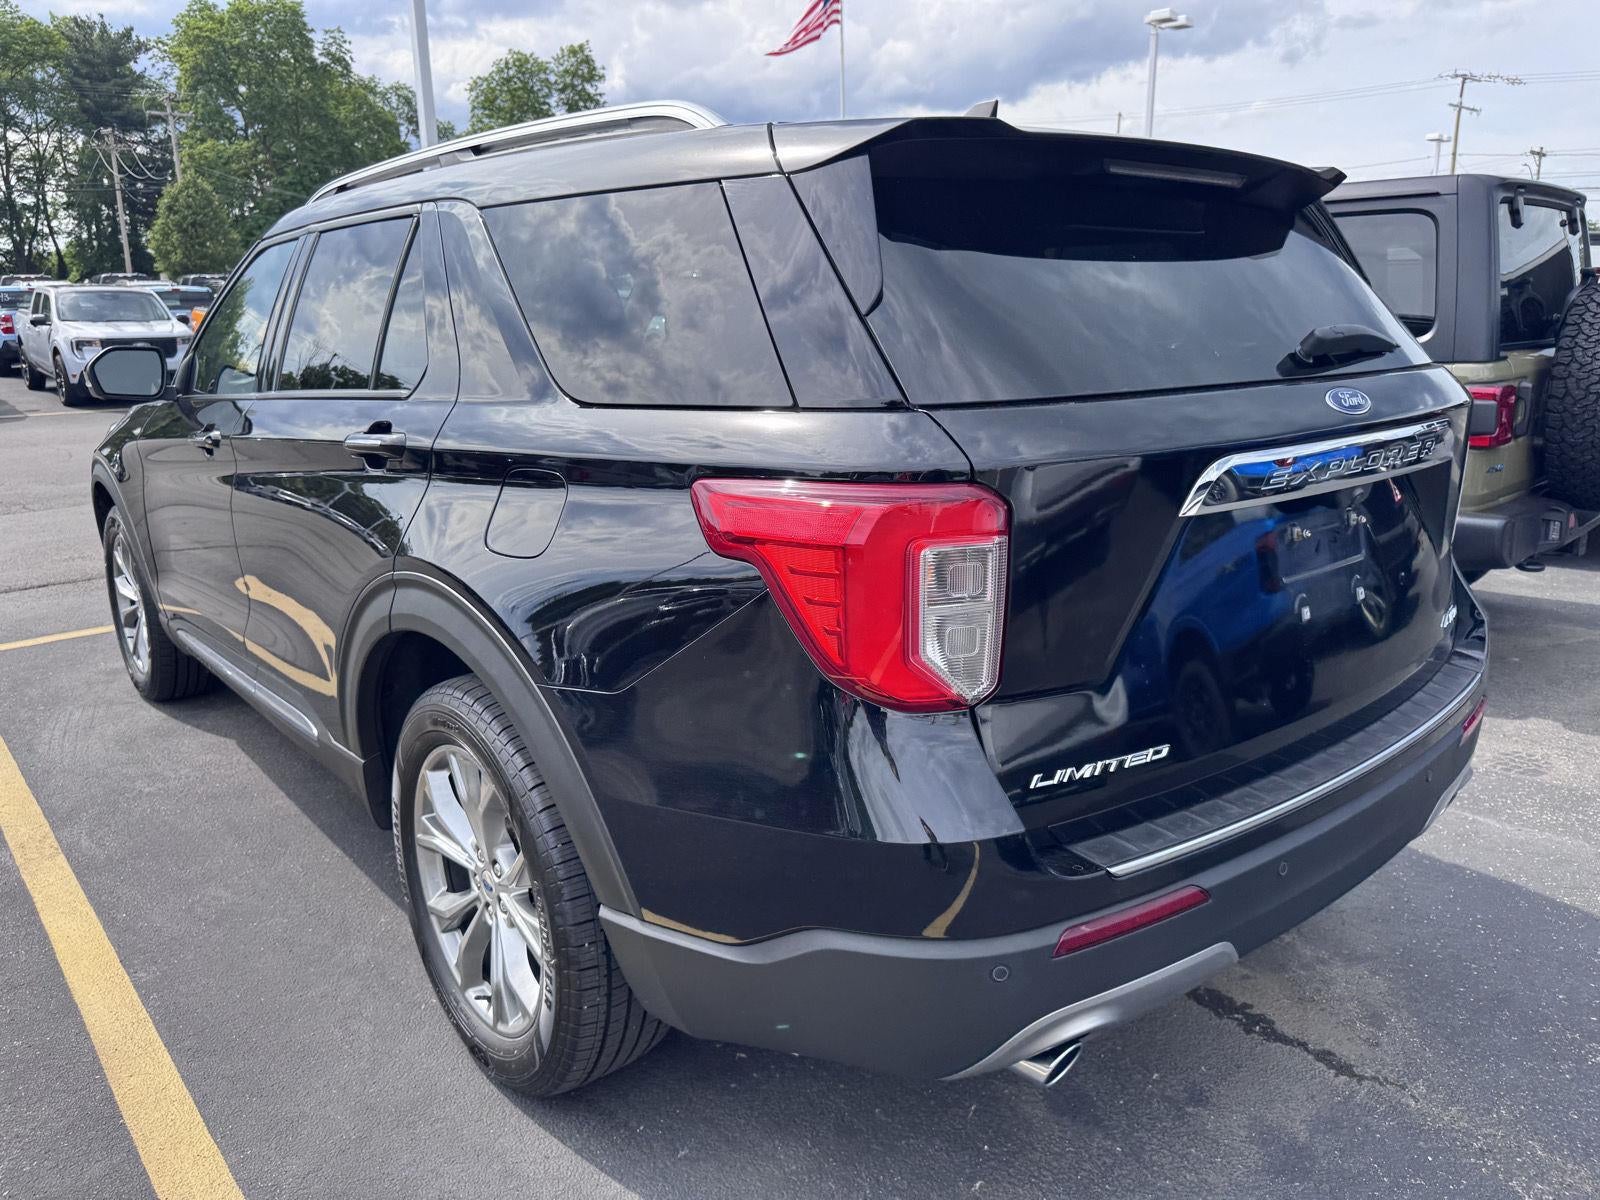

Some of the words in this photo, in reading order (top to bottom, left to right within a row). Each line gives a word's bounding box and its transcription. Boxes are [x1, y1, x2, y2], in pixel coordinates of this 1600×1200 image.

[1337, 391, 1366, 407] Ford
[1261, 438, 1437, 491] EXPLORER
[1029, 743, 1171, 789] LIMITED
